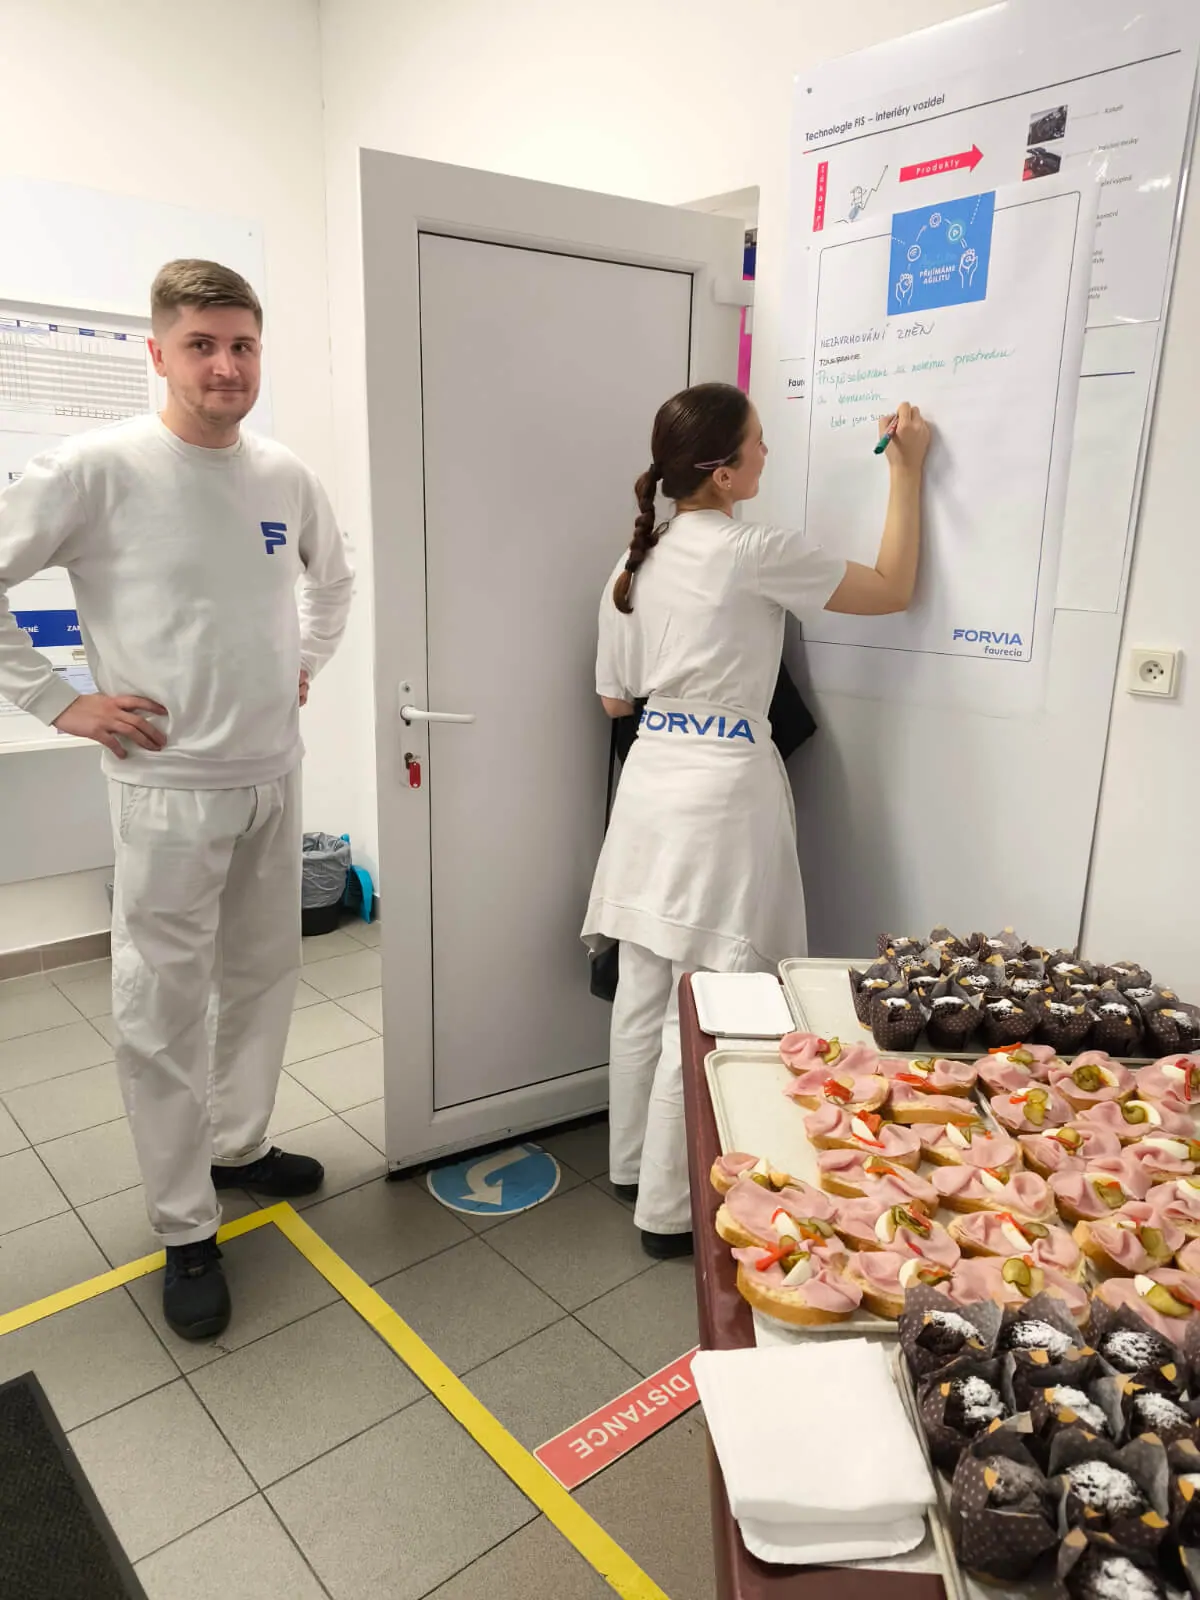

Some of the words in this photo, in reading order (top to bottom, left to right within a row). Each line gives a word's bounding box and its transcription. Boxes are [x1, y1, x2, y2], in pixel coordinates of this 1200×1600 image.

[805, 120, 852, 141] Technologie
[854, 116, 865, 128] FIS
[875, 105, 911, 122] interiéry
[912, 94, 945, 112] vozidel
[915, 158, 960, 176] Produkty
[923, 273, 951, 285] AGILITU
[952, 629, 1023, 646] FORVIA
[984, 645, 1022, 657] faurecia
[567, 1373, 692, 1459] DISTANCE
